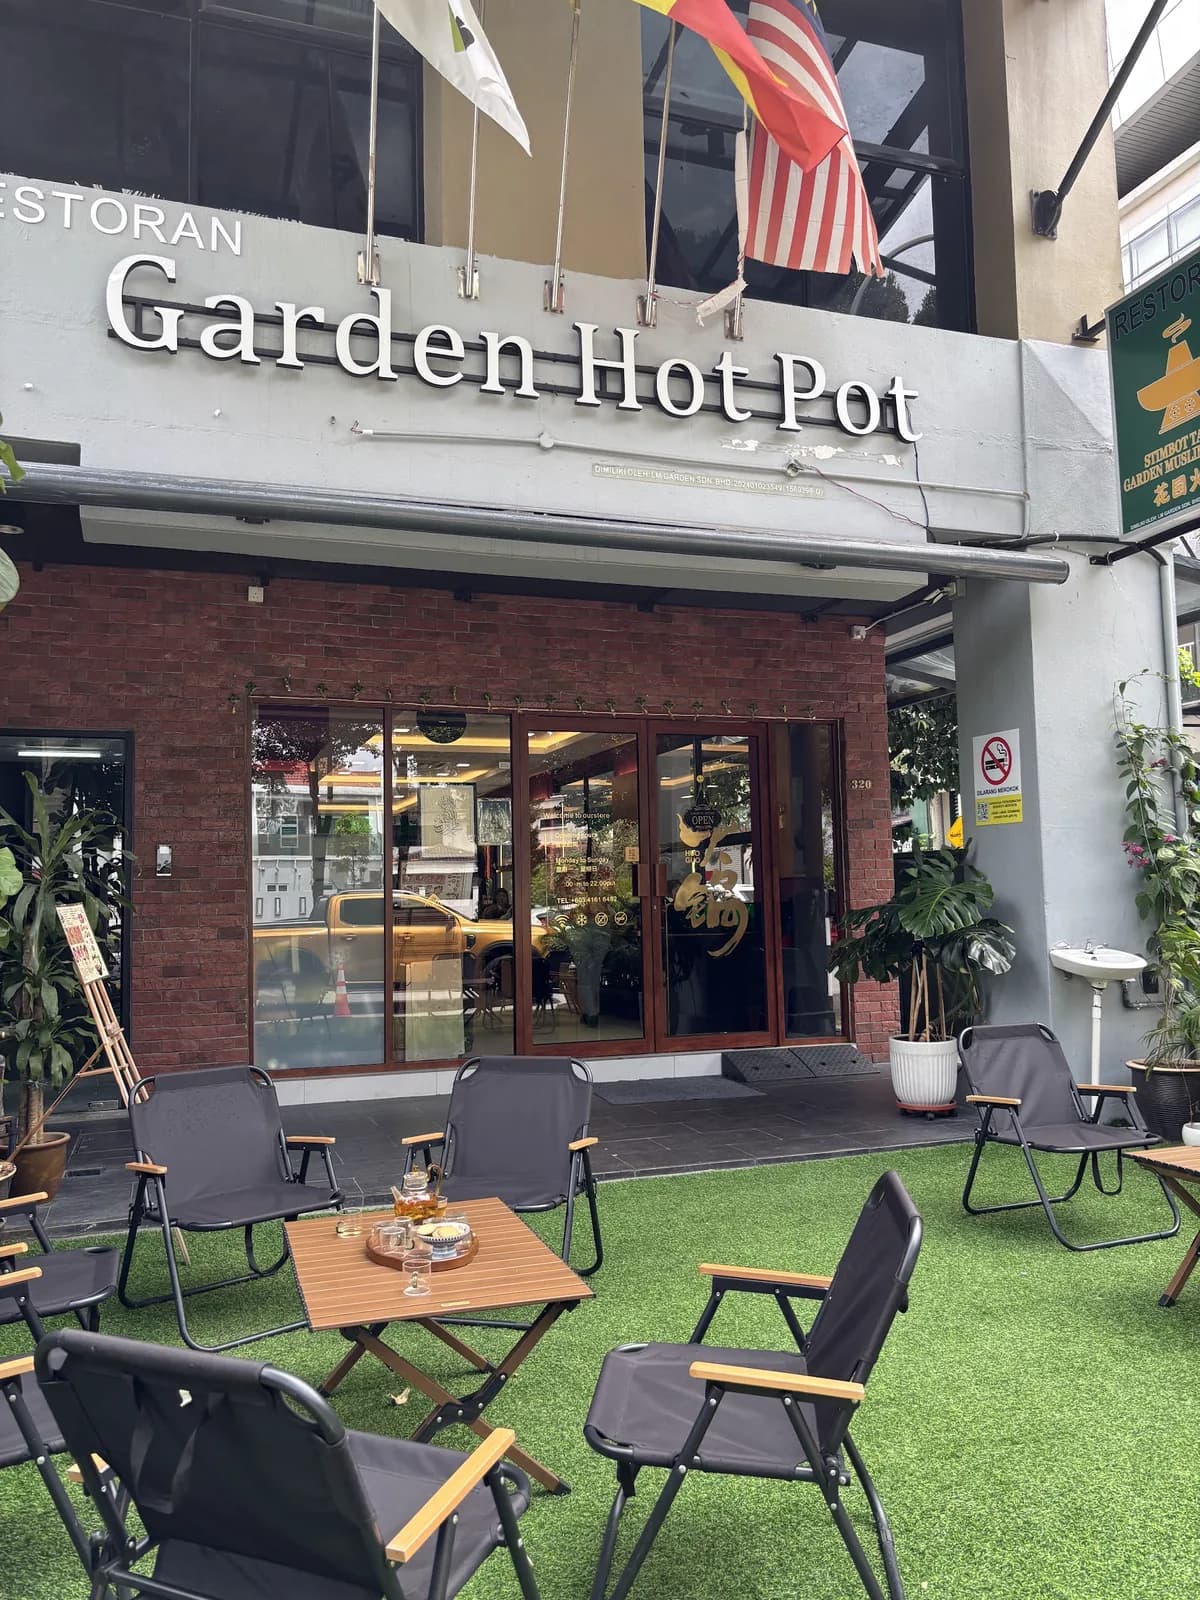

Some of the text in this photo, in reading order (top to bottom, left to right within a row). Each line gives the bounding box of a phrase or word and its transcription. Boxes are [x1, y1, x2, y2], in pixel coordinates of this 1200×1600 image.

[0, 182, 243, 256] STORAN
[105, 253, 924, 443] Garden Hot Pot
[1144, 435, 1188, 468] STIMBOT
[663, 472, 694, 483] GARDEN
[1123, 463, 1163, 493] GARDEN
[851, 779, 871, 789] 320
[691, 815, 714, 825] OPEN
[556, 857, 579, 865] Monday
[587, 856, 609, 864] Sunday
